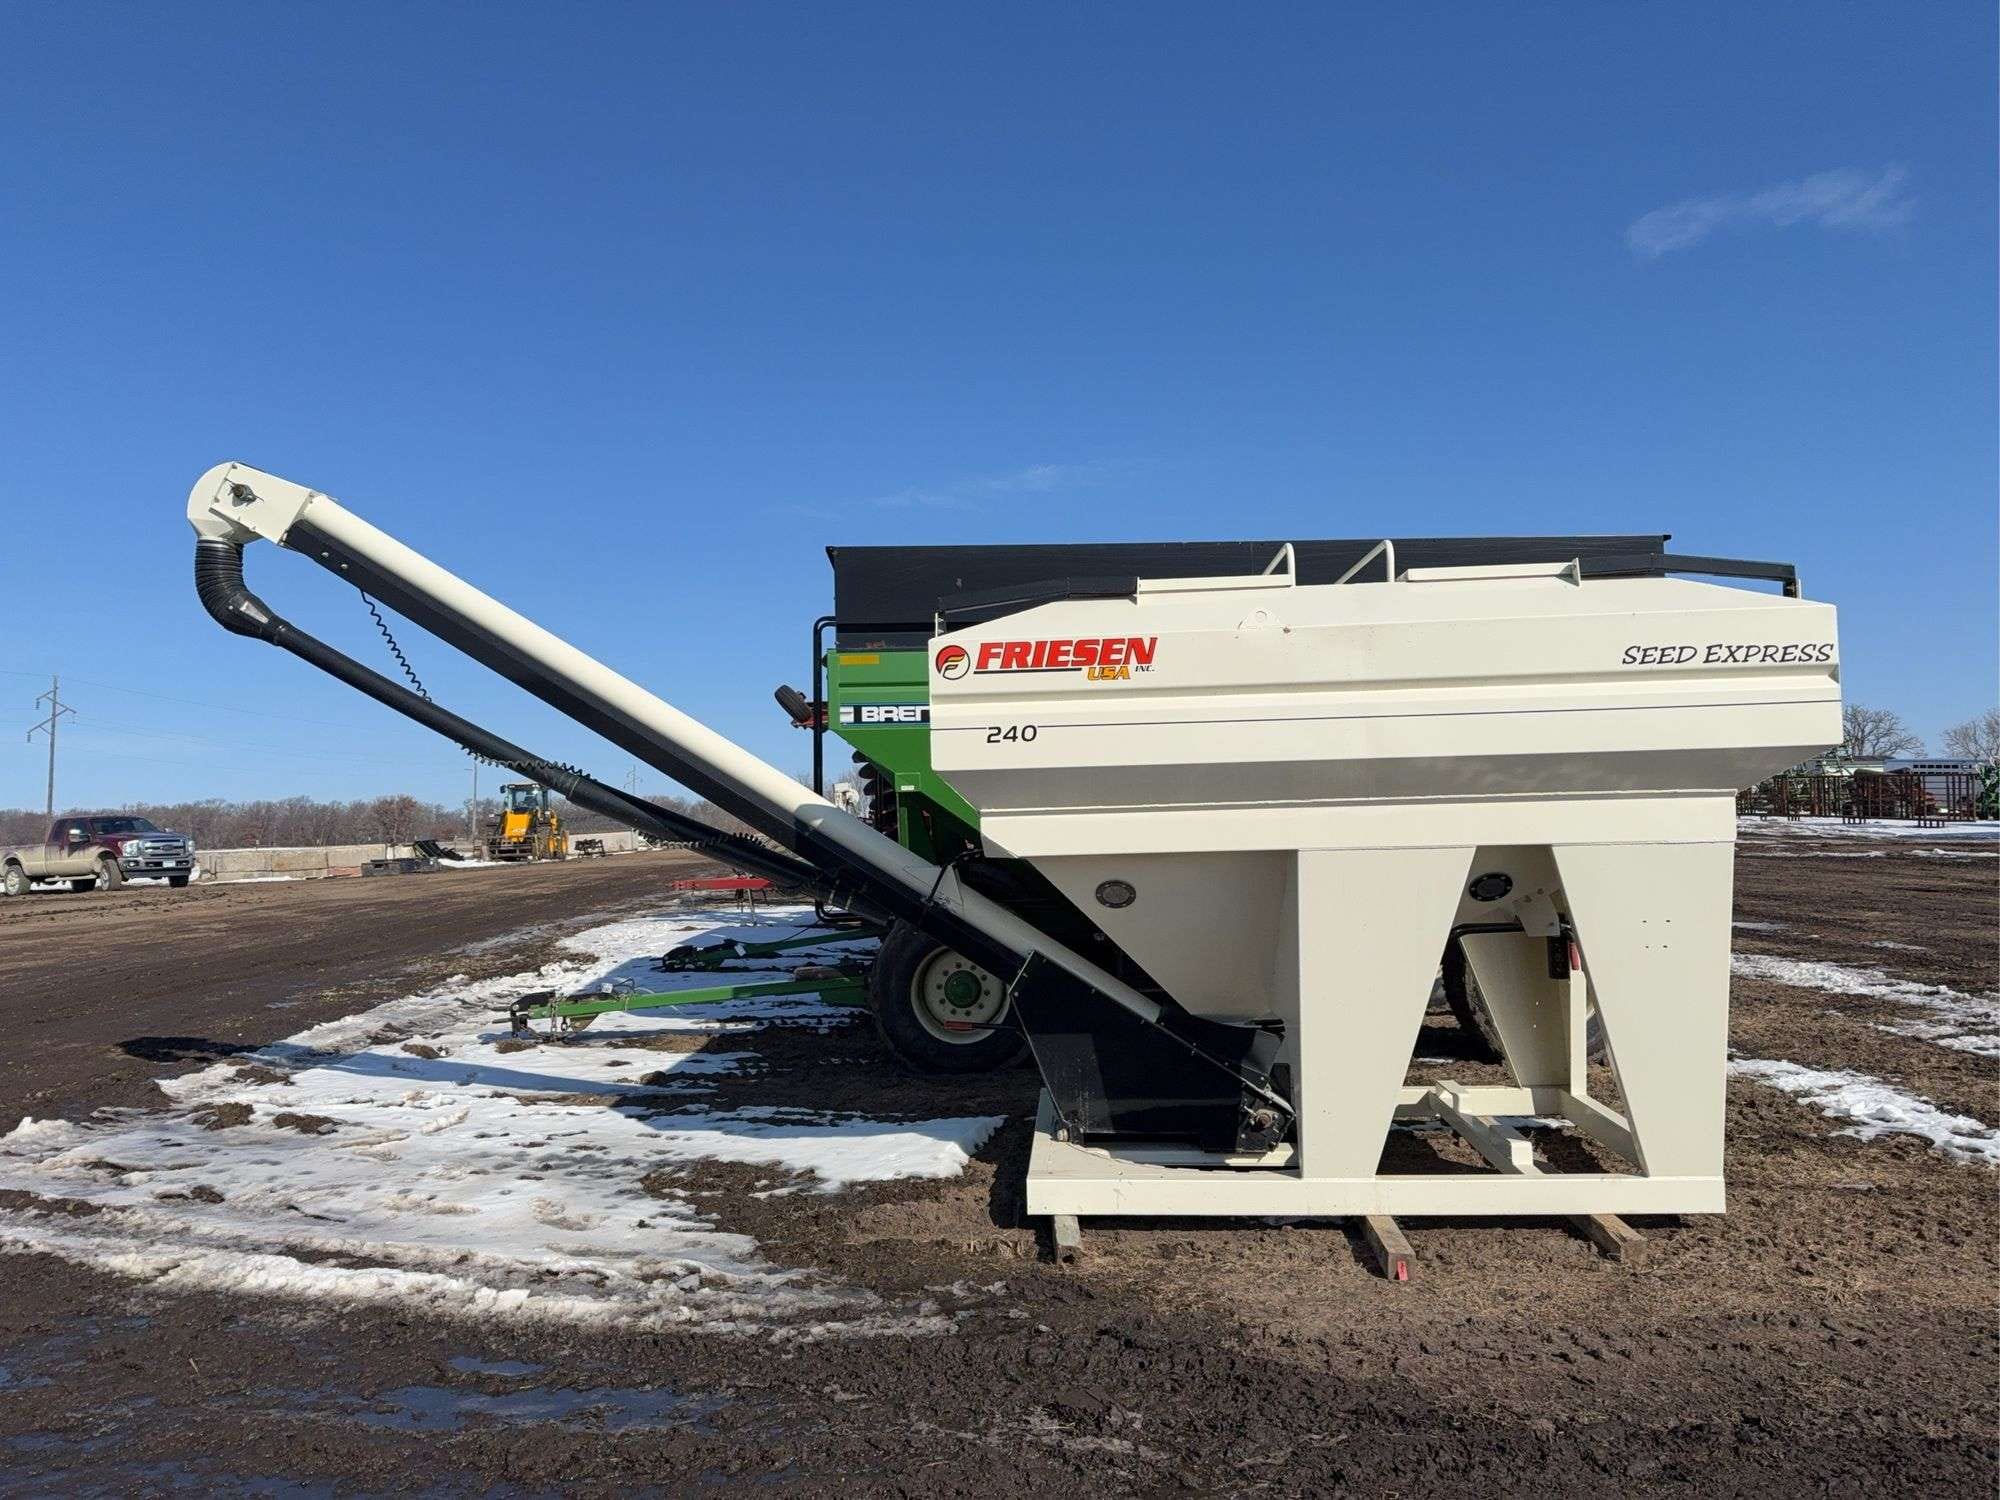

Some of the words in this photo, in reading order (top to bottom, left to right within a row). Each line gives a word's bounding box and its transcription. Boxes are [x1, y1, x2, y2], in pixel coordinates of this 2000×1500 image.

[975, 637, 1158, 670] FRIESEN
[1622, 645, 1698, 665] SEED
[1703, 643, 1835, 664] EXPRESS
[1087, 664, 1131, 681] USA
[1135, 665, 1155, 673] INC.
[986, 725, 1038, 744] 240
